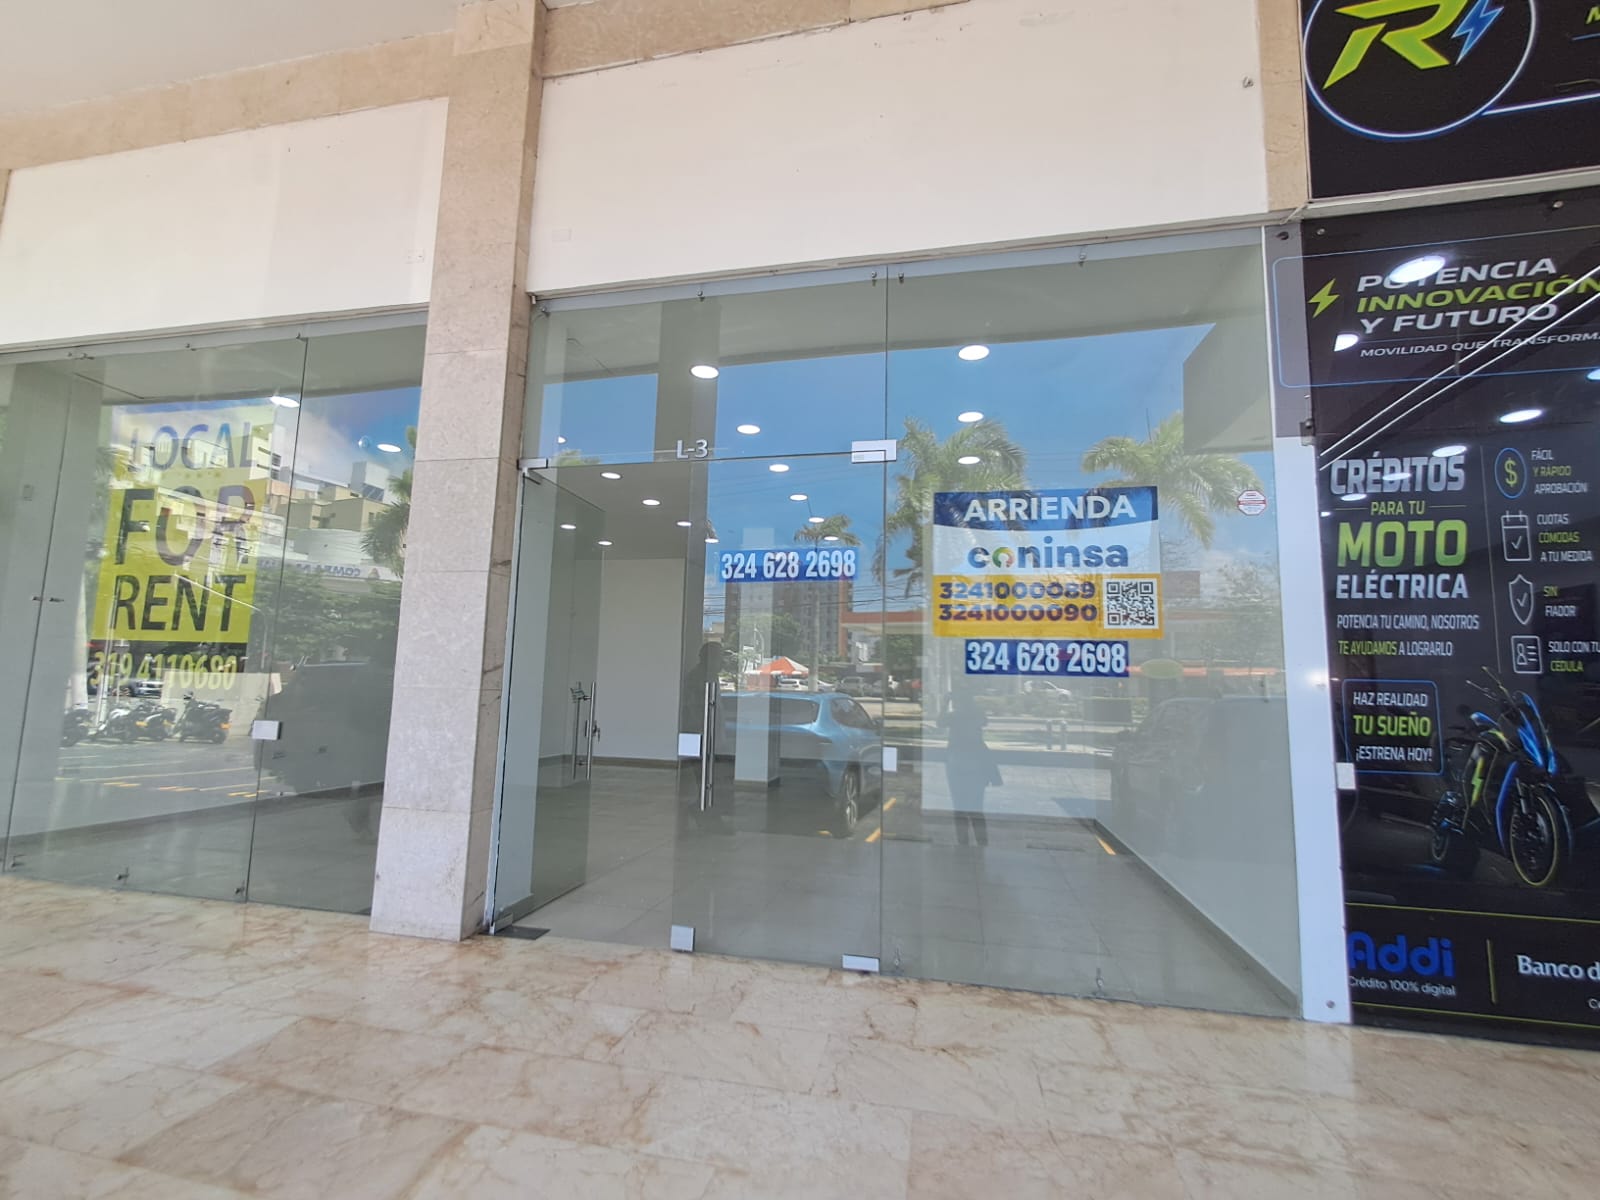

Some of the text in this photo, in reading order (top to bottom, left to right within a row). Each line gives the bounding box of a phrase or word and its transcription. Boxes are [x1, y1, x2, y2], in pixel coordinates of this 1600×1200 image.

[1356, 274, 1600, 314] INNOVACIÓN
[1360, 303, 1557, 334] Y FUTURO
[1360, 344, 1448, 358] MOVILIDAD
[1451, 341, 1486, 352] QUE
[676, 439, 708, 459] L-3
[1330, 451, 1465, 495] CRÉDITOS
[1532, 466, 1540, 477] Y
[963, 494, 1136, 522] ARRIENDA
[1371, 500, 1426, 516] PARA TU
[1536, 513, 1569, 525] CUOTAS
[114, 485, 255, 566] FOR
[967, 535, 1129, 569] coninsa
[1337, 519, 1468, 568] MOTO
[721, 549, 856, 580] 324 628 2698
[1539, 550, 1594, 563] A TU MEDIDA
[938, 581, 1096, 600] 3241000089
[1335, 569, 1469, 599] ELÉCTRICA
[1543, 585, 1558, 597] SIN
[110, 574, 246, 632] RENT
[938, 603, 1098, 622] 3241000090
[1545, 605, 1577, 617] FIADOR
[1337, 614, 1379, 629] POTENCIA
[1380, 614, 1392, 629] TU
[1431, 615, 1480, 630] NOSOTROS
[967, 641, 1127, 674] 324 628 2698
[1338, 640, 1453, 657] TE AYUDAMOS A LOGRARLO
[1548, 641, 1570, 653] SOLO
[1571, 641, 1590, 653] CON
[136, 652, 237, 691] 4110680
[1352, 691, 1429, 708] HAZ REALIDAD
[1352, 711, 1432, 737] TU SUEÑO
[1355, 746, 1433, 762] ¡ESTRENA HOY!
[1348, 931, 1455, 977] Addi
[1516, 954, 1585, 979] Banco
[1349, 975, 1457, 998] Crédito 100% digital
